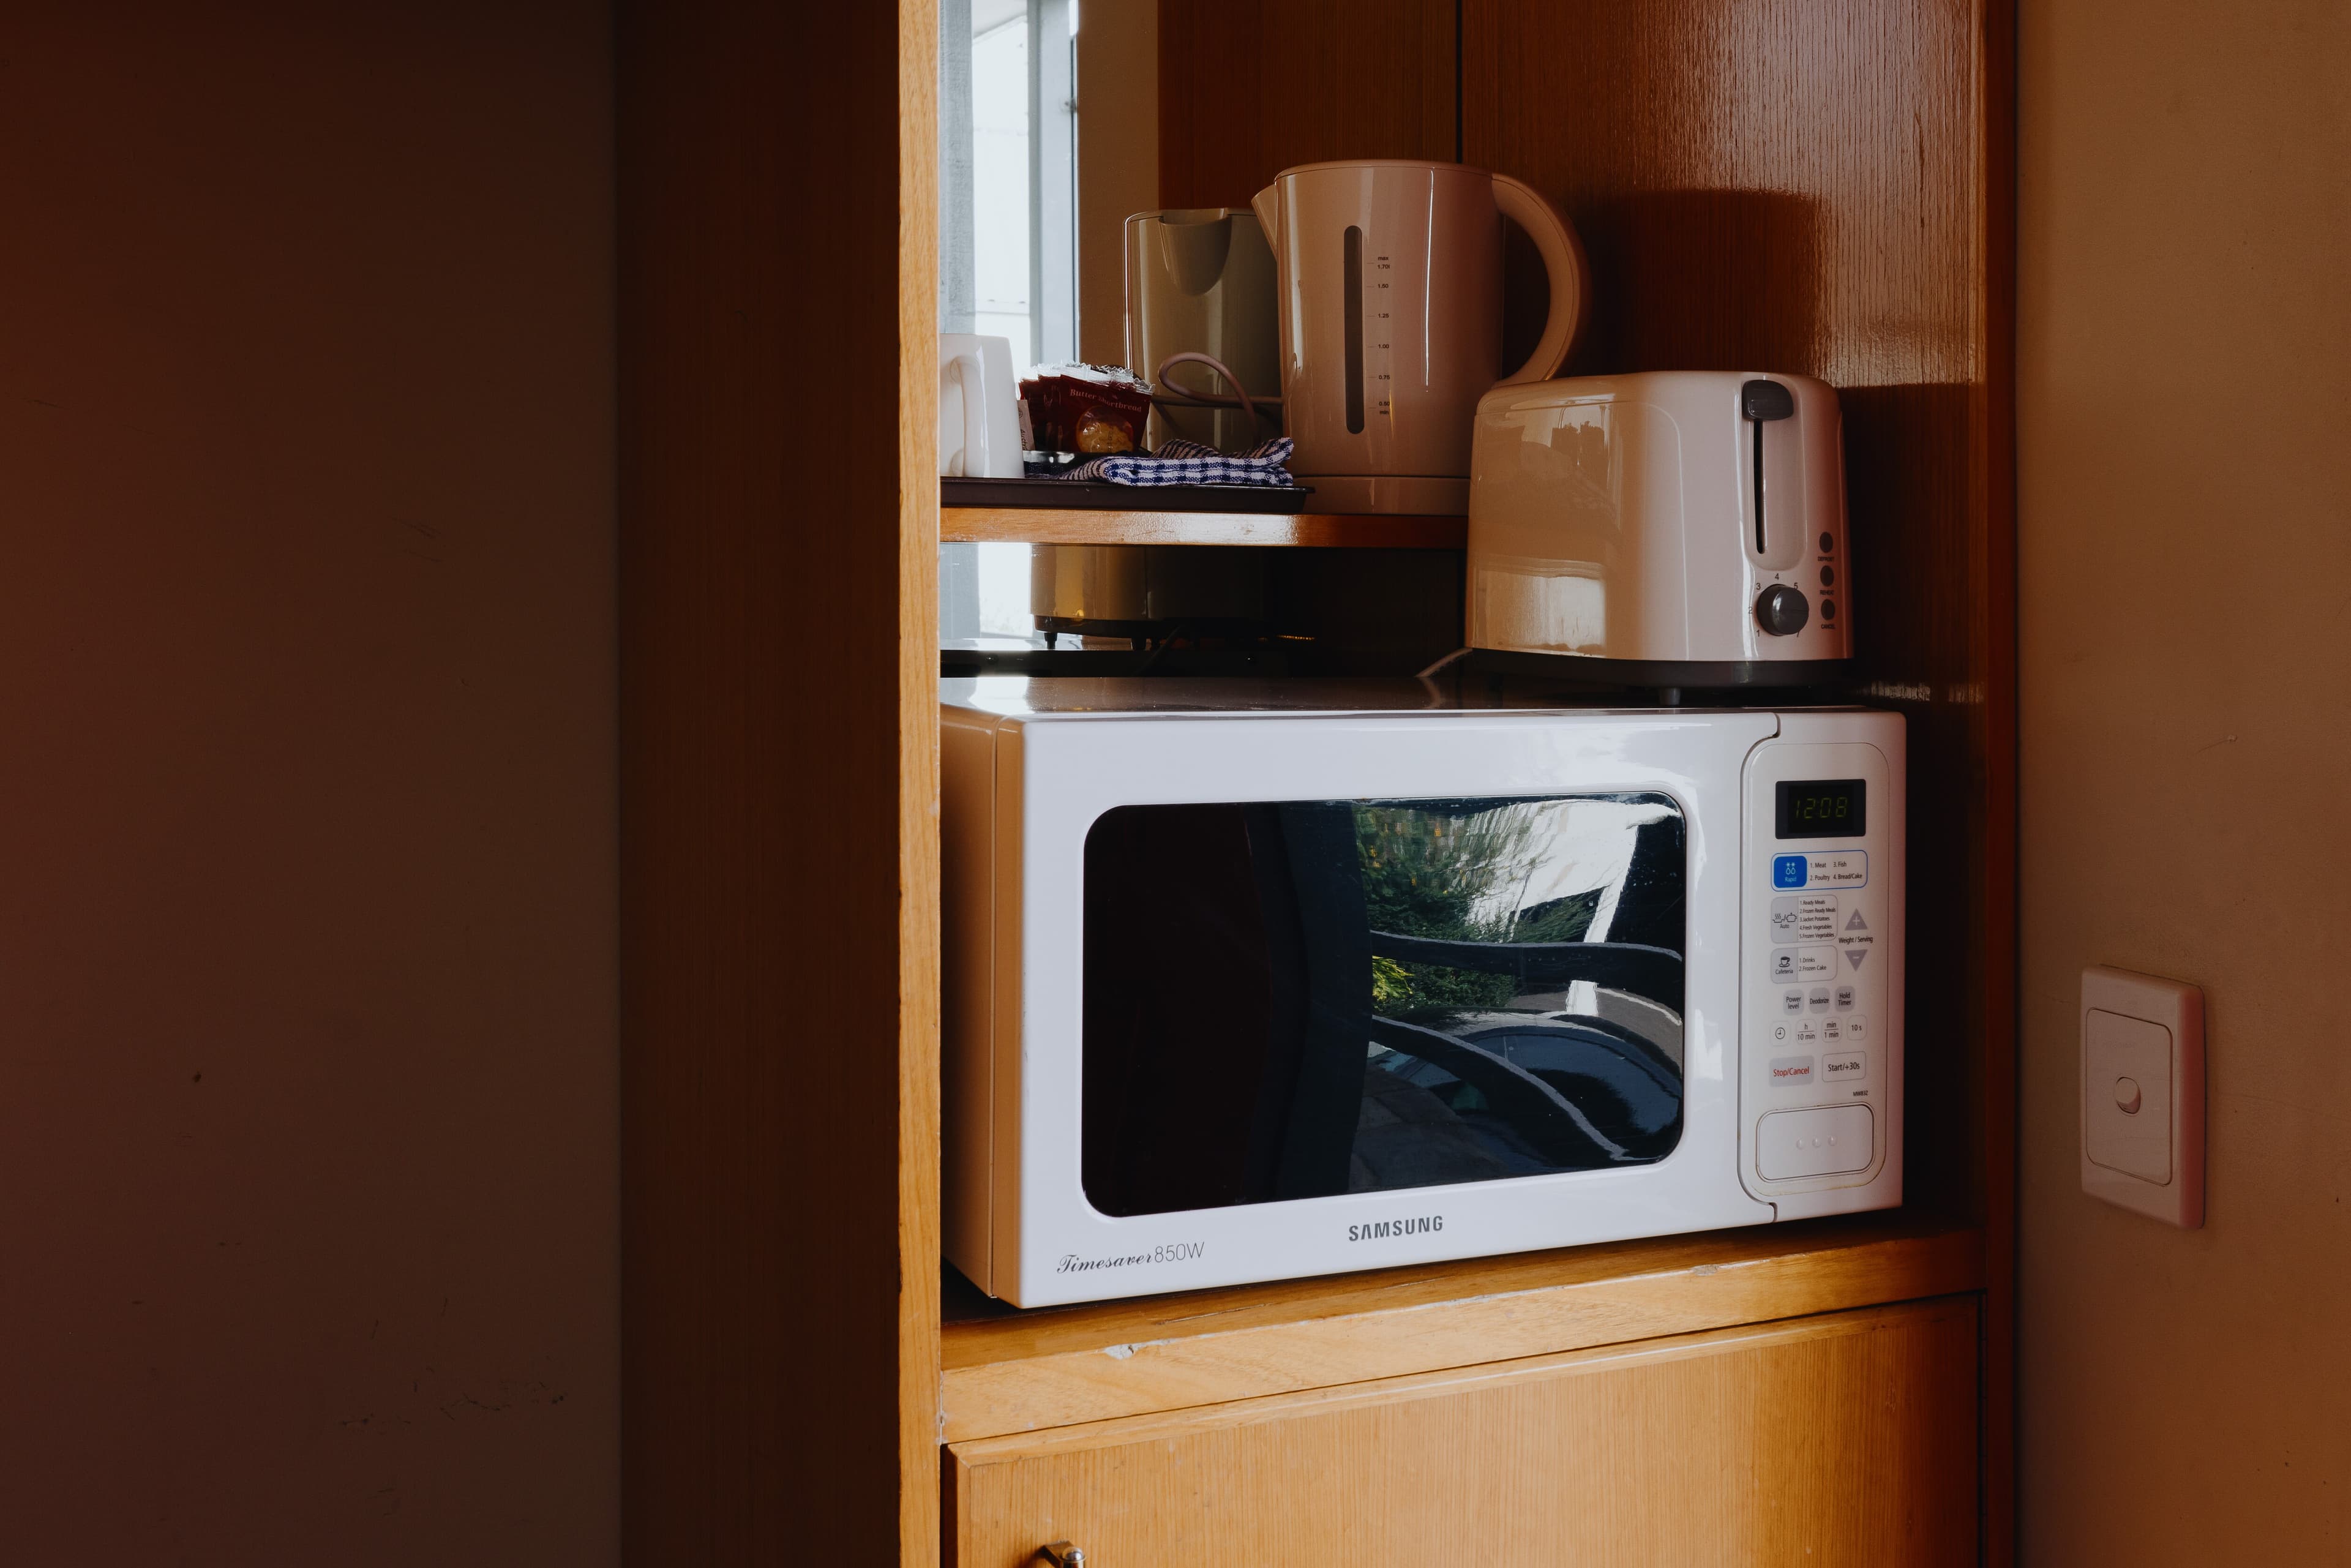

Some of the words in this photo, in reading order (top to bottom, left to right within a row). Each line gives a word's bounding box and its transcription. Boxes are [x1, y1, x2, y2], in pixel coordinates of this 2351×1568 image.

[1070, 388, 1098, 400] Butter
[1839, 936, 1854, 945] Weight
[1773, 1066, 1810, 1078] Stop/Cancel
[1828, 1062, 1860, 1072] Start/+30s
[1348, 1215, 1443, 1242] SAMSUNG
